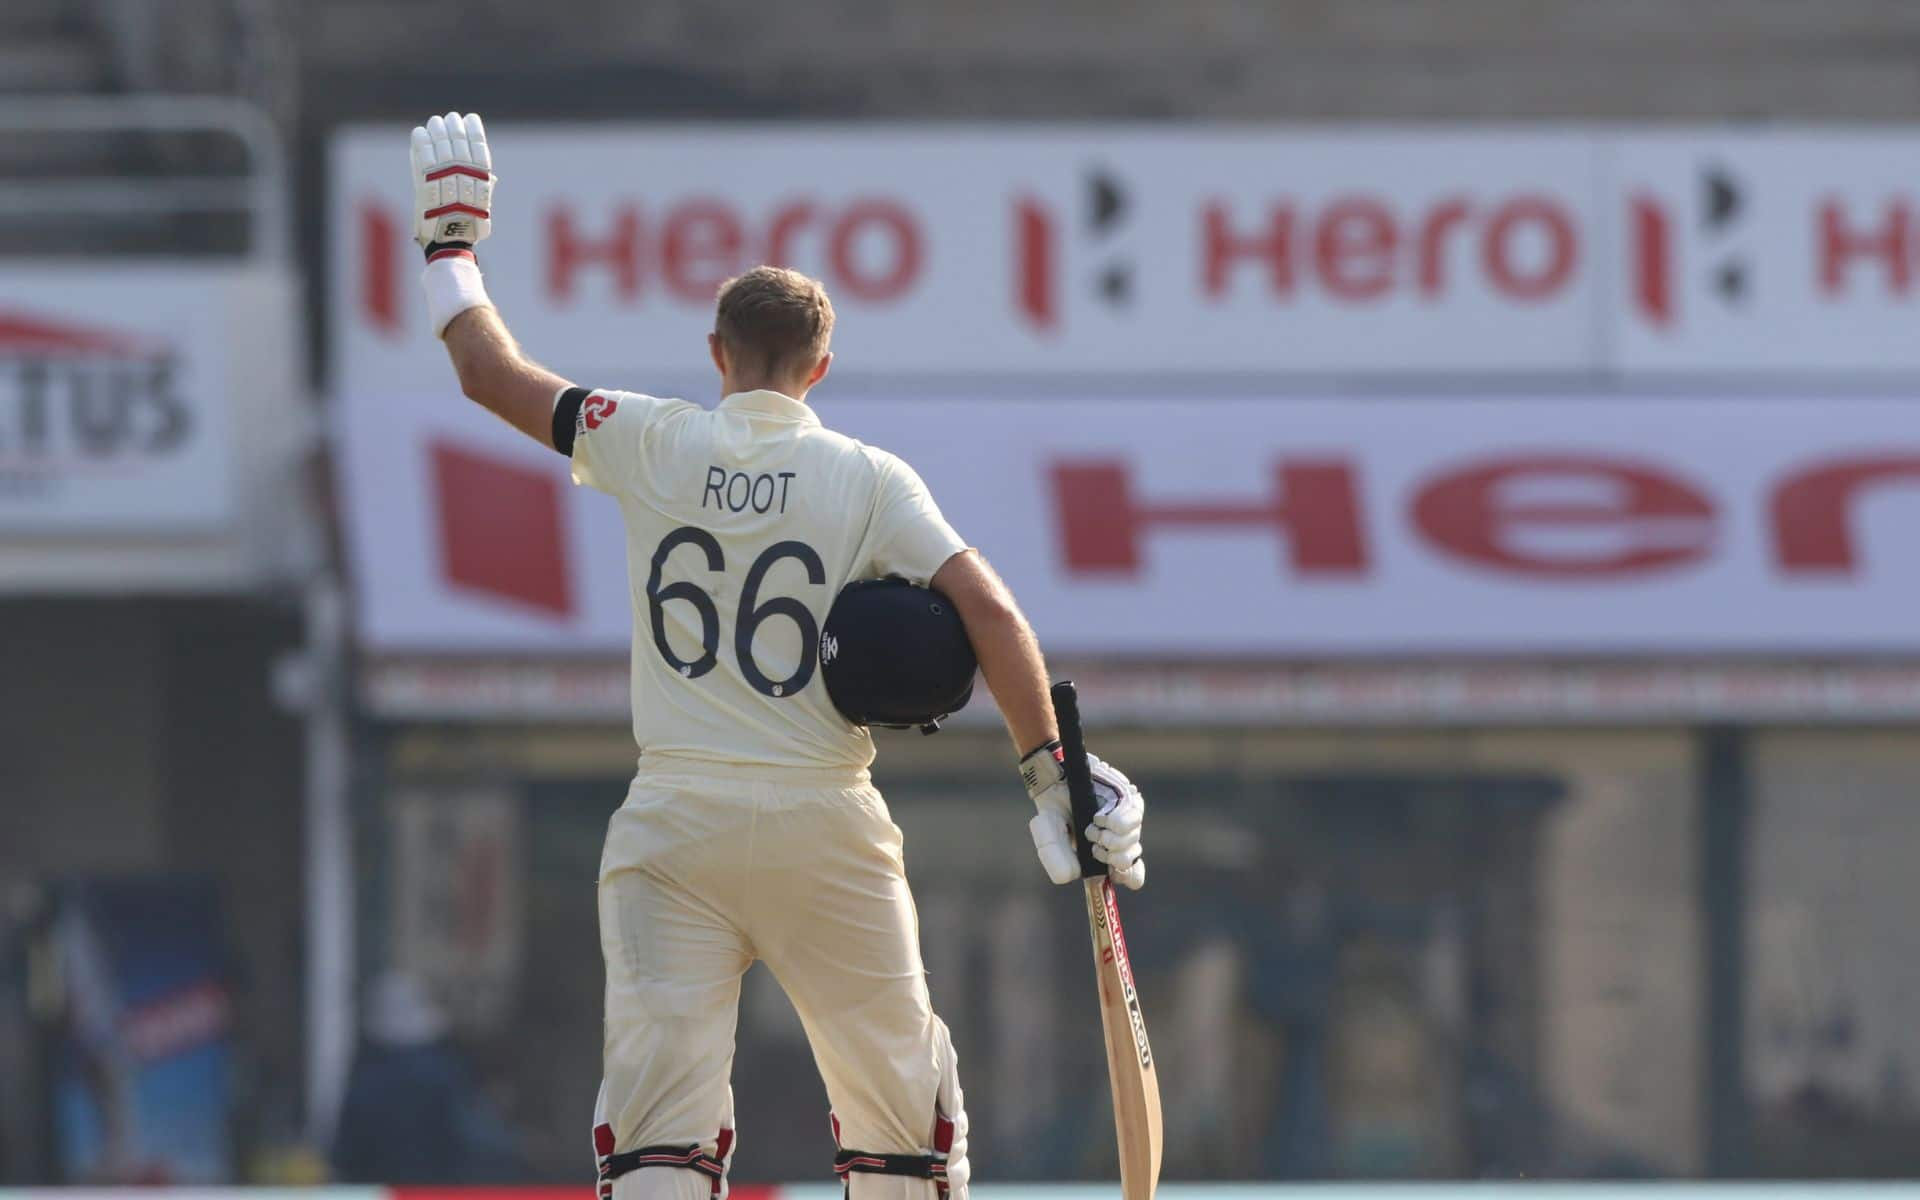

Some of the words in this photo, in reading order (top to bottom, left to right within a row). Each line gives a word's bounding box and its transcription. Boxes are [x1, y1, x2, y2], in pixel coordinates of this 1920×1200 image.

[545, 196, 928, 305] Hero
[1202, 194, 1579, 302] Hero
[1815, 194, 1920, 302] H
[0, 352, 193, 456] TUS
[702, 465, 796, 514] ROOT
[646, 526, 826, 698] 66
[1131, 1010, 1150, 1065] new
